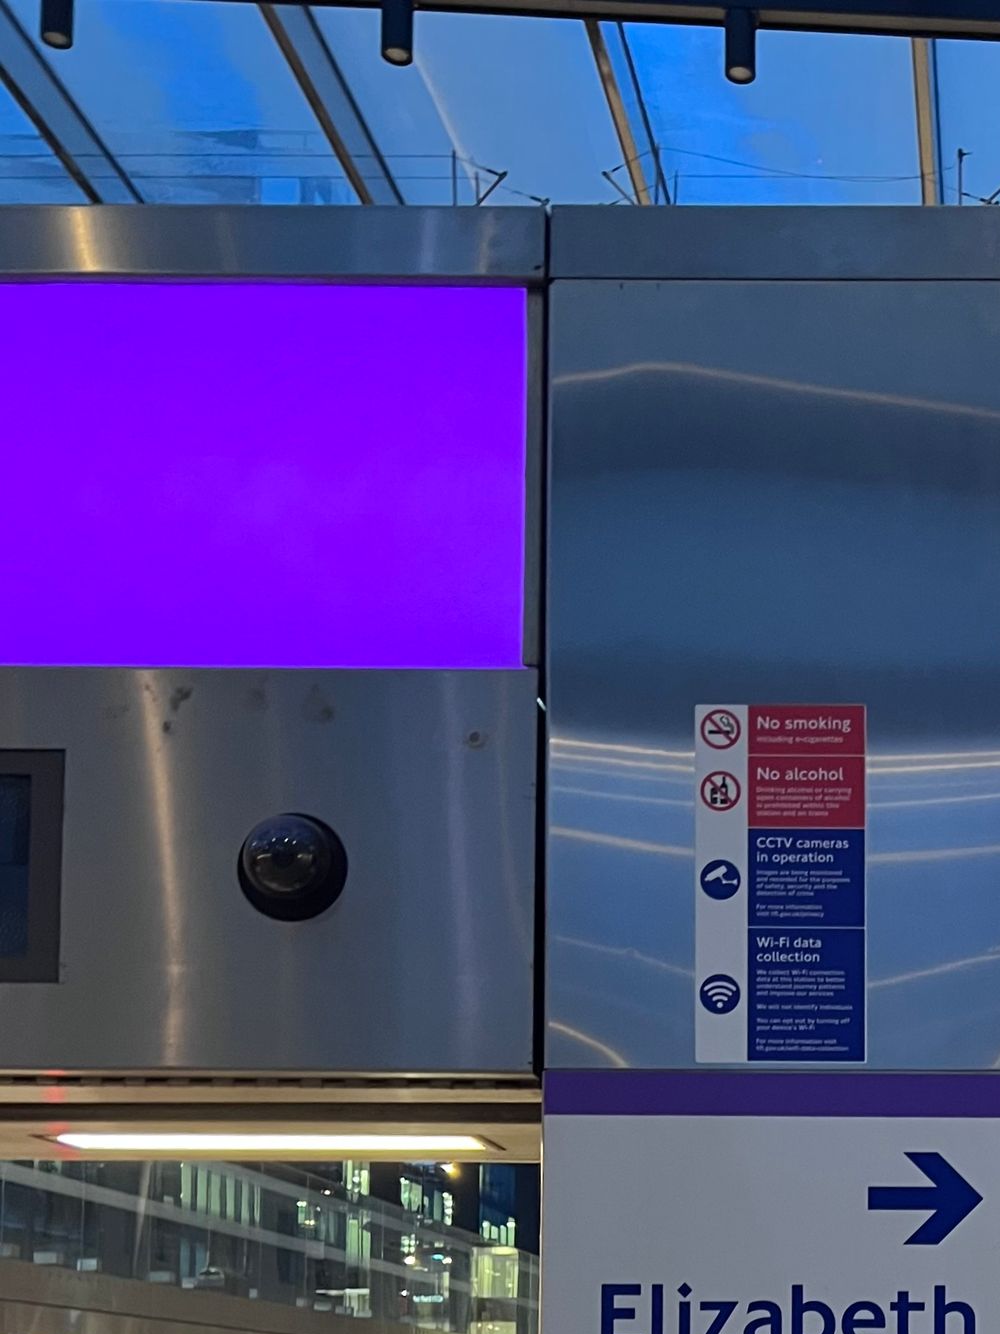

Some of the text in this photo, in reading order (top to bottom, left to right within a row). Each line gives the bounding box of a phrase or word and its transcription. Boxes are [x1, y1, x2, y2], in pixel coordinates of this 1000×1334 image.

[756, 716, 852, 734] No smoking
[756, 766, 844, 781] No alcohol
[756, 837, 850, 849] CCTV cameras
[756, 851, 835, 866] in operation
[756, 936, 822, 949] Wi-Fi data
[756, 951, 820, 963] collection
